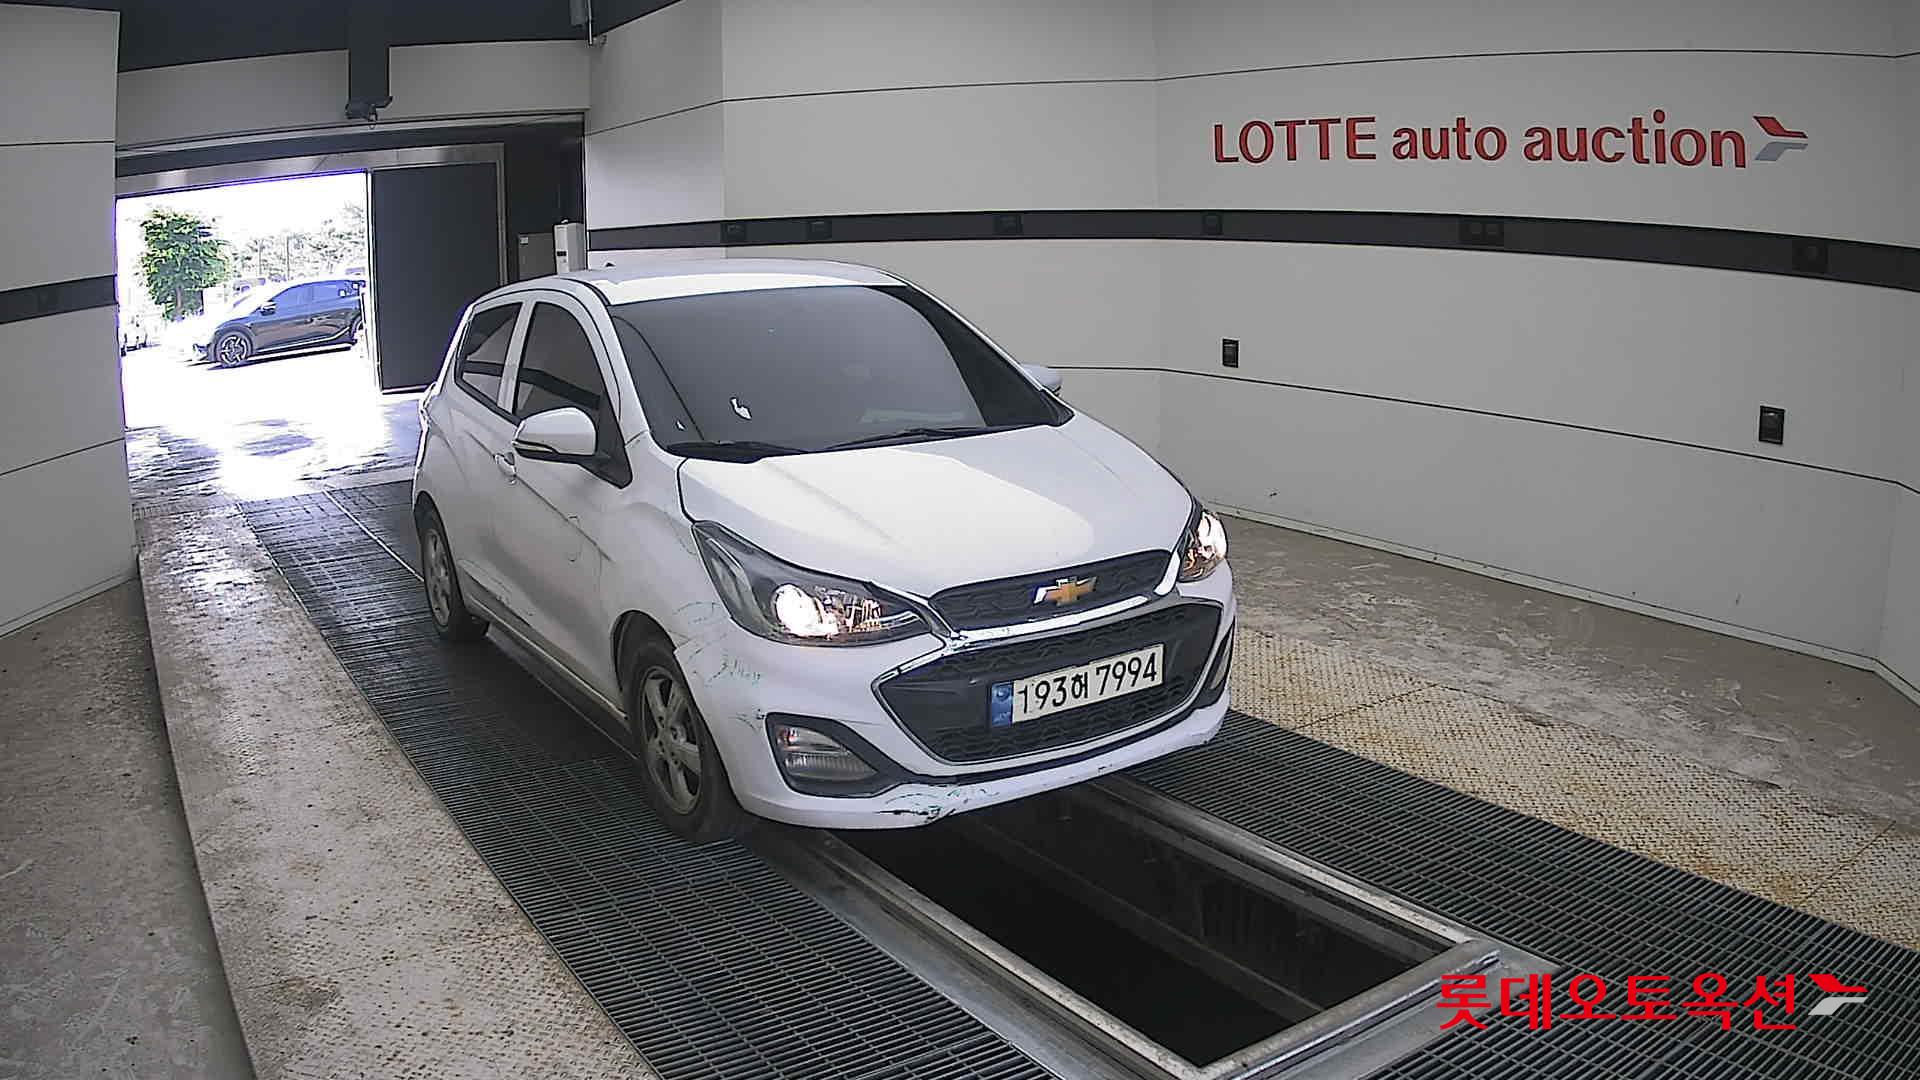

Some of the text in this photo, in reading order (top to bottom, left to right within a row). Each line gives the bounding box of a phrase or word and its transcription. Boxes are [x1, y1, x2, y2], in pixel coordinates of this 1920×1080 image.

[1213, 109, 1747, 169] LOTTE auto auction
[1017, 652, 1157, 714] 193허 7994
